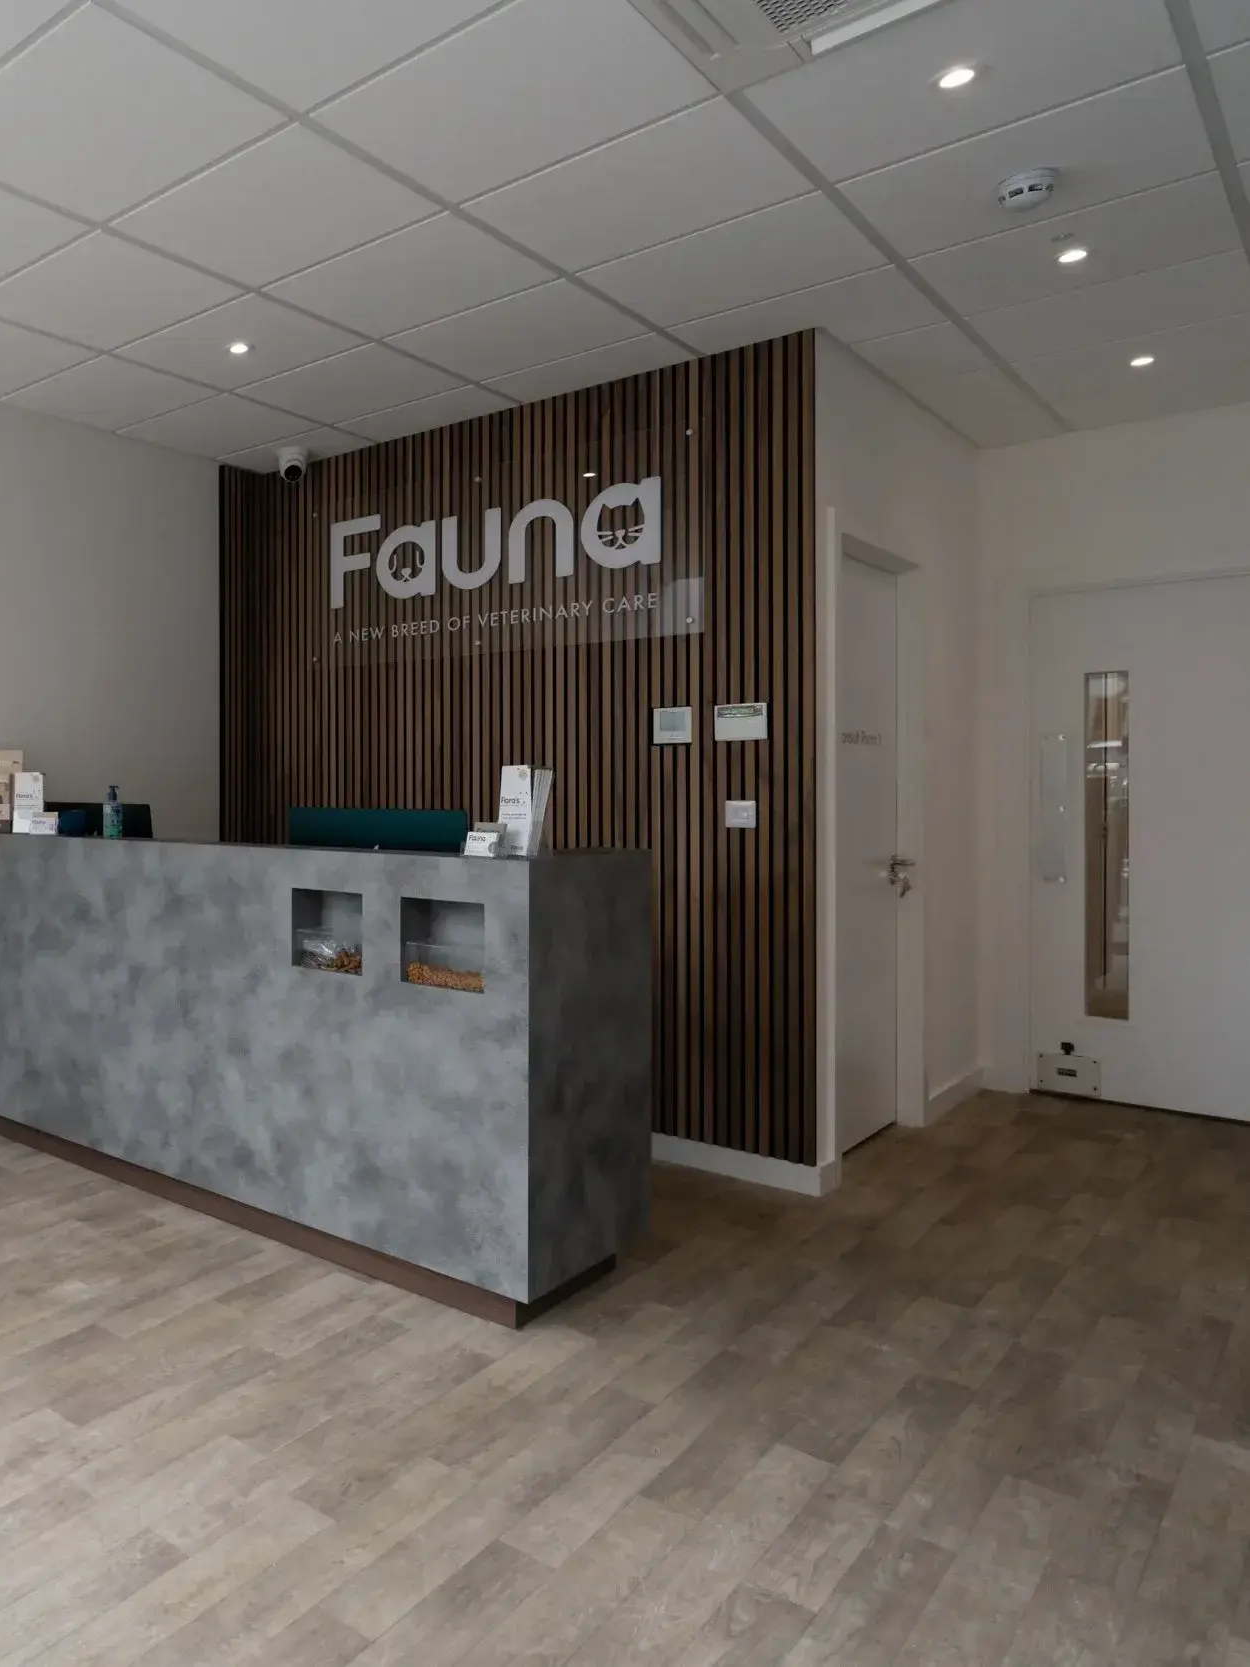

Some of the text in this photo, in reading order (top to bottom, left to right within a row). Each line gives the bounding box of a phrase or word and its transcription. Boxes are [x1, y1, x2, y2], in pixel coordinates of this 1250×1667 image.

[330, 476, 661, 609] Fauna
[332, 593, 659, 645] A NEW BREED OF VETERINARY CARE
